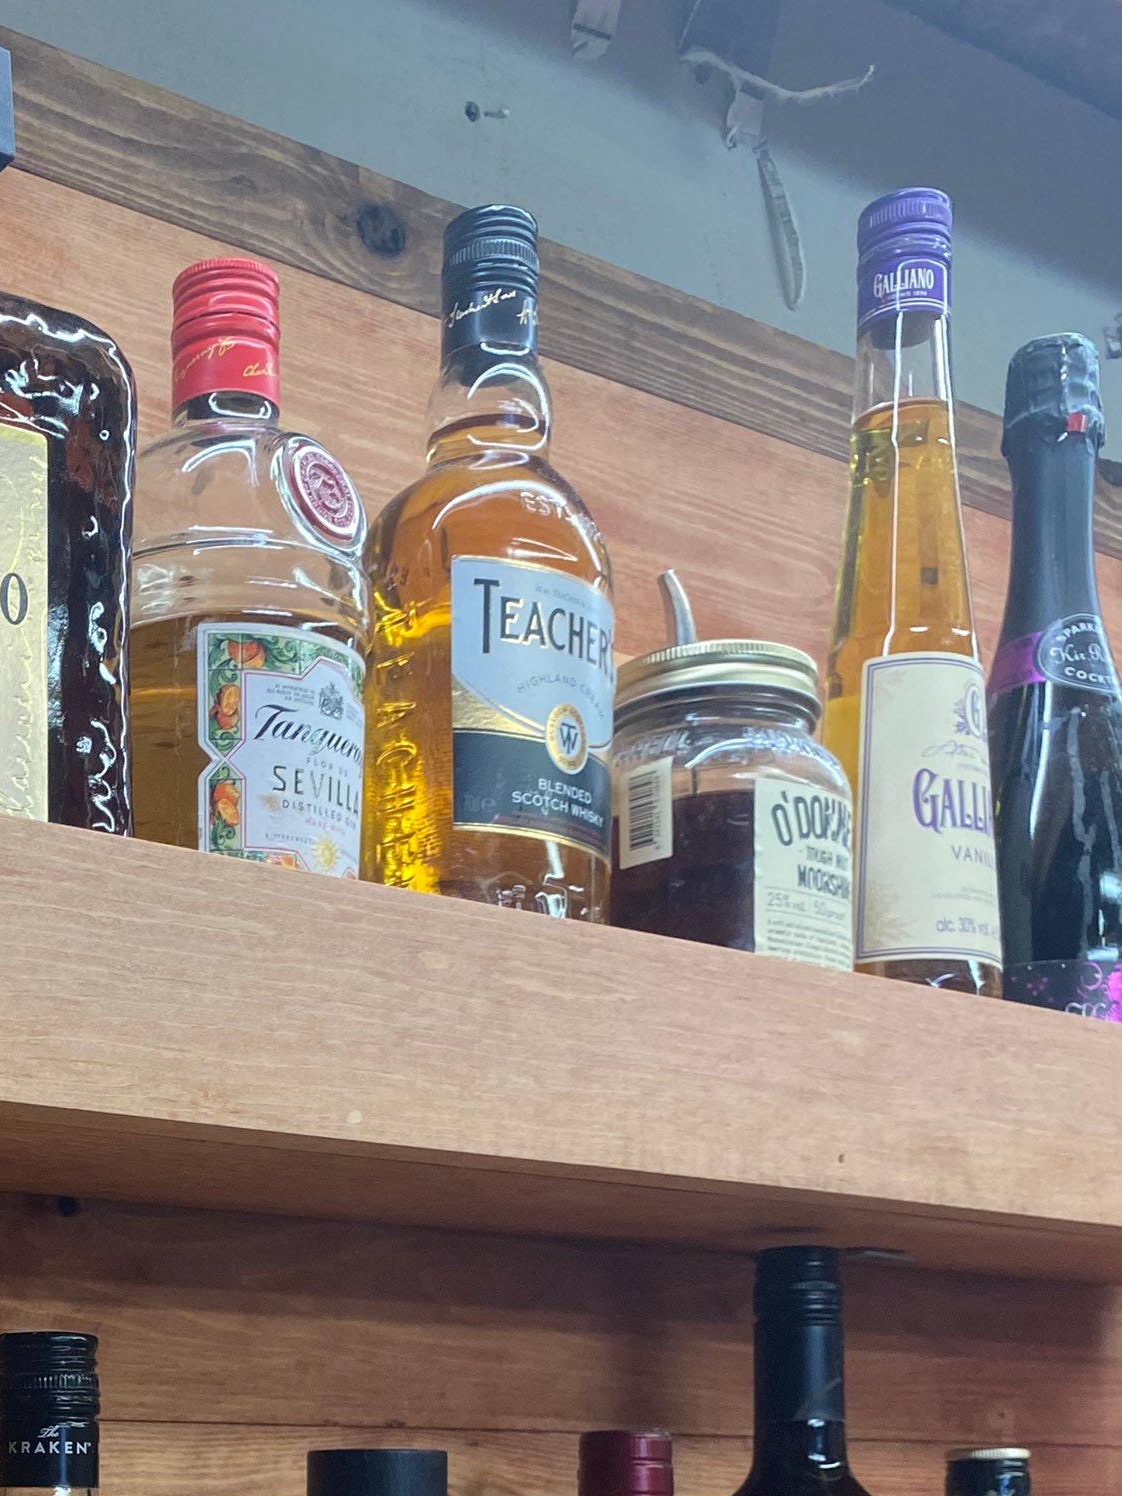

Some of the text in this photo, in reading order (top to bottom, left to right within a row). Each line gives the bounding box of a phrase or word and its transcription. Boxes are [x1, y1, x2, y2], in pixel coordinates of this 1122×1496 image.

[873, 267, 935, 298] GALLIANO
[472, 578, 614, 684] TEACHER'
[1056, 622, 1097, 643] SPARK
[516, 673, 577, 694] HIGHLAND
[306, 756, 334, 771] FLOR
[538, 778, 592, 805] BLENDED
[282, 799, 342, 822] DISTILLED
[511, 790, 569, 814] SCOTCH
[571, 803, 605, 829] WHISKY
[37, 1424, 60, 1438] The
[8, 1441, 89, 1455] KRAKEN
